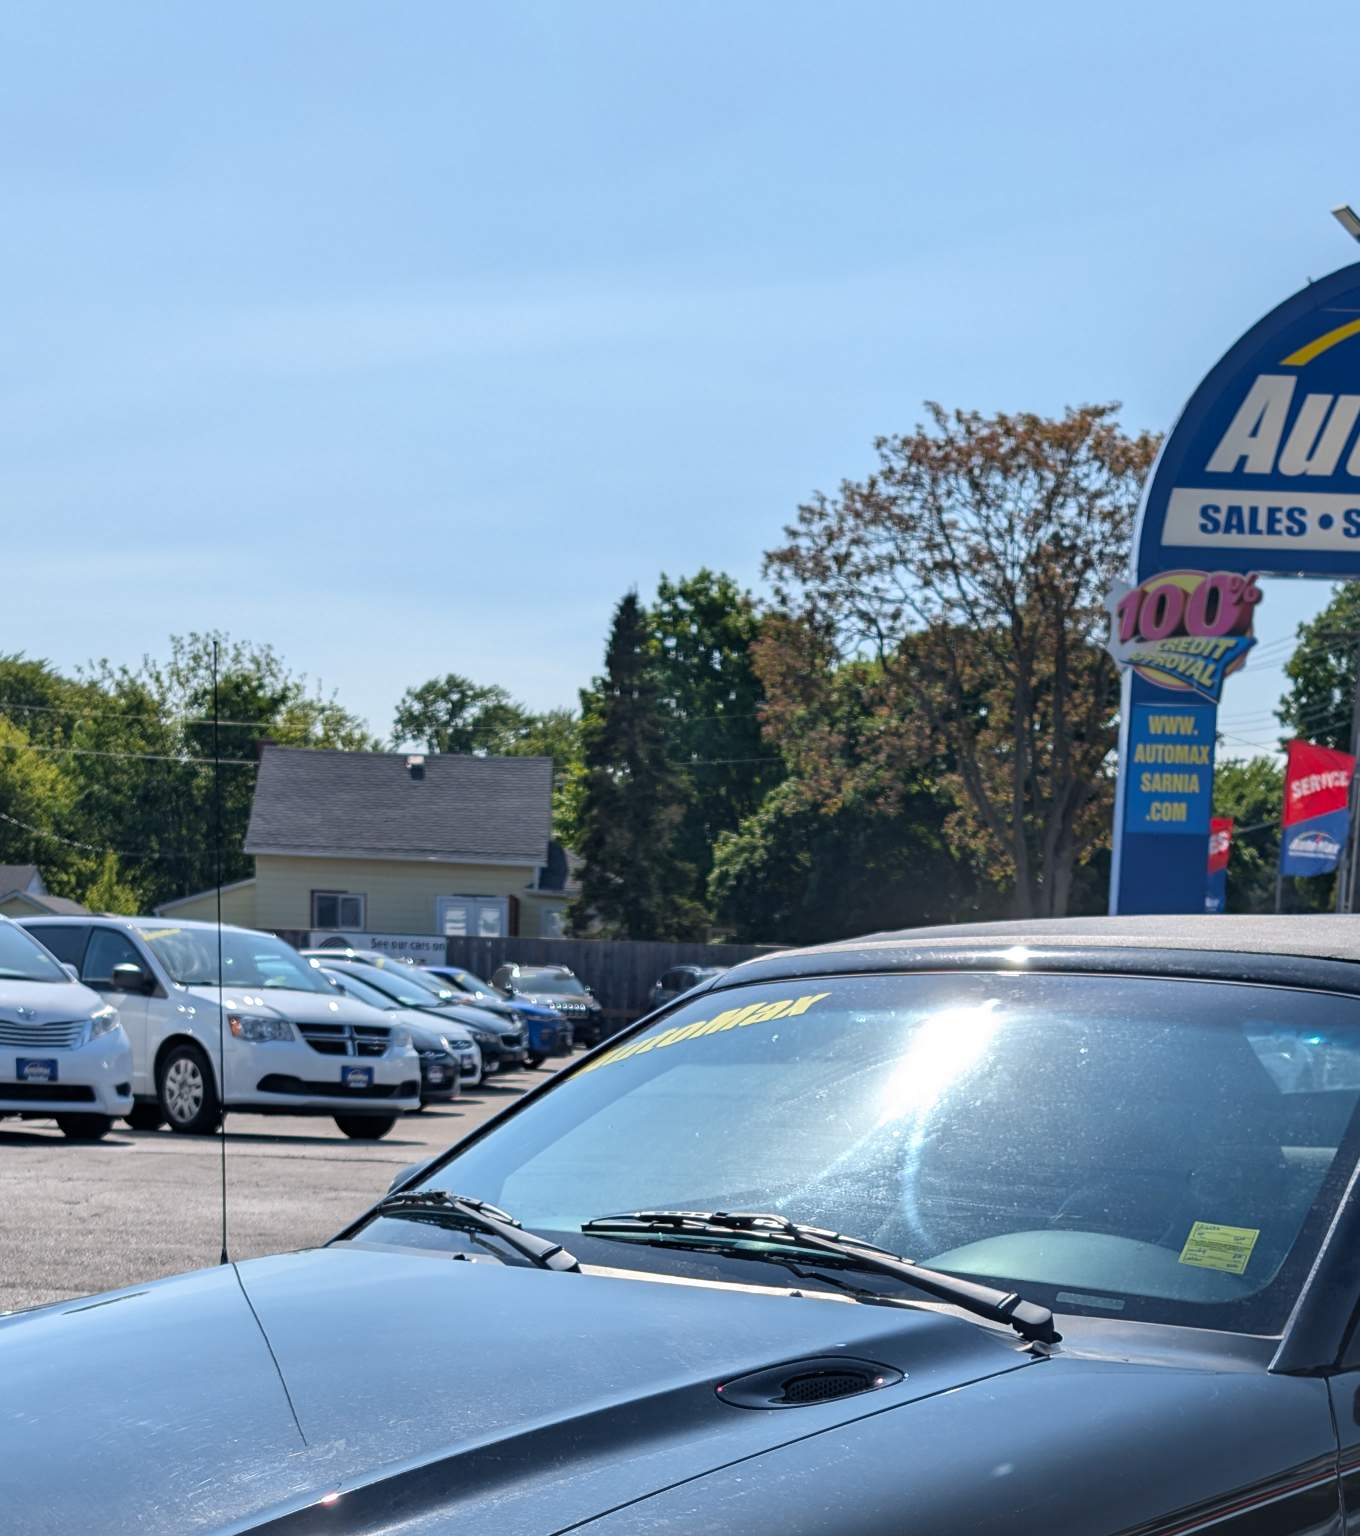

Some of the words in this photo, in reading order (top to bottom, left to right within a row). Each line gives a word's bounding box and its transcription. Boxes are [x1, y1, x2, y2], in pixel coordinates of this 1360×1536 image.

[1198, 504, 1307, 537] SALES
[1117, 571, 1262, 644] 100%
[1148, 715, 1199, 736] WWW.
[1134, 743, 1209, 765] AUTOMAX
[1140, 772, 1200, 793] SARNIA
[1145, 801, 1188, 822] .COM
